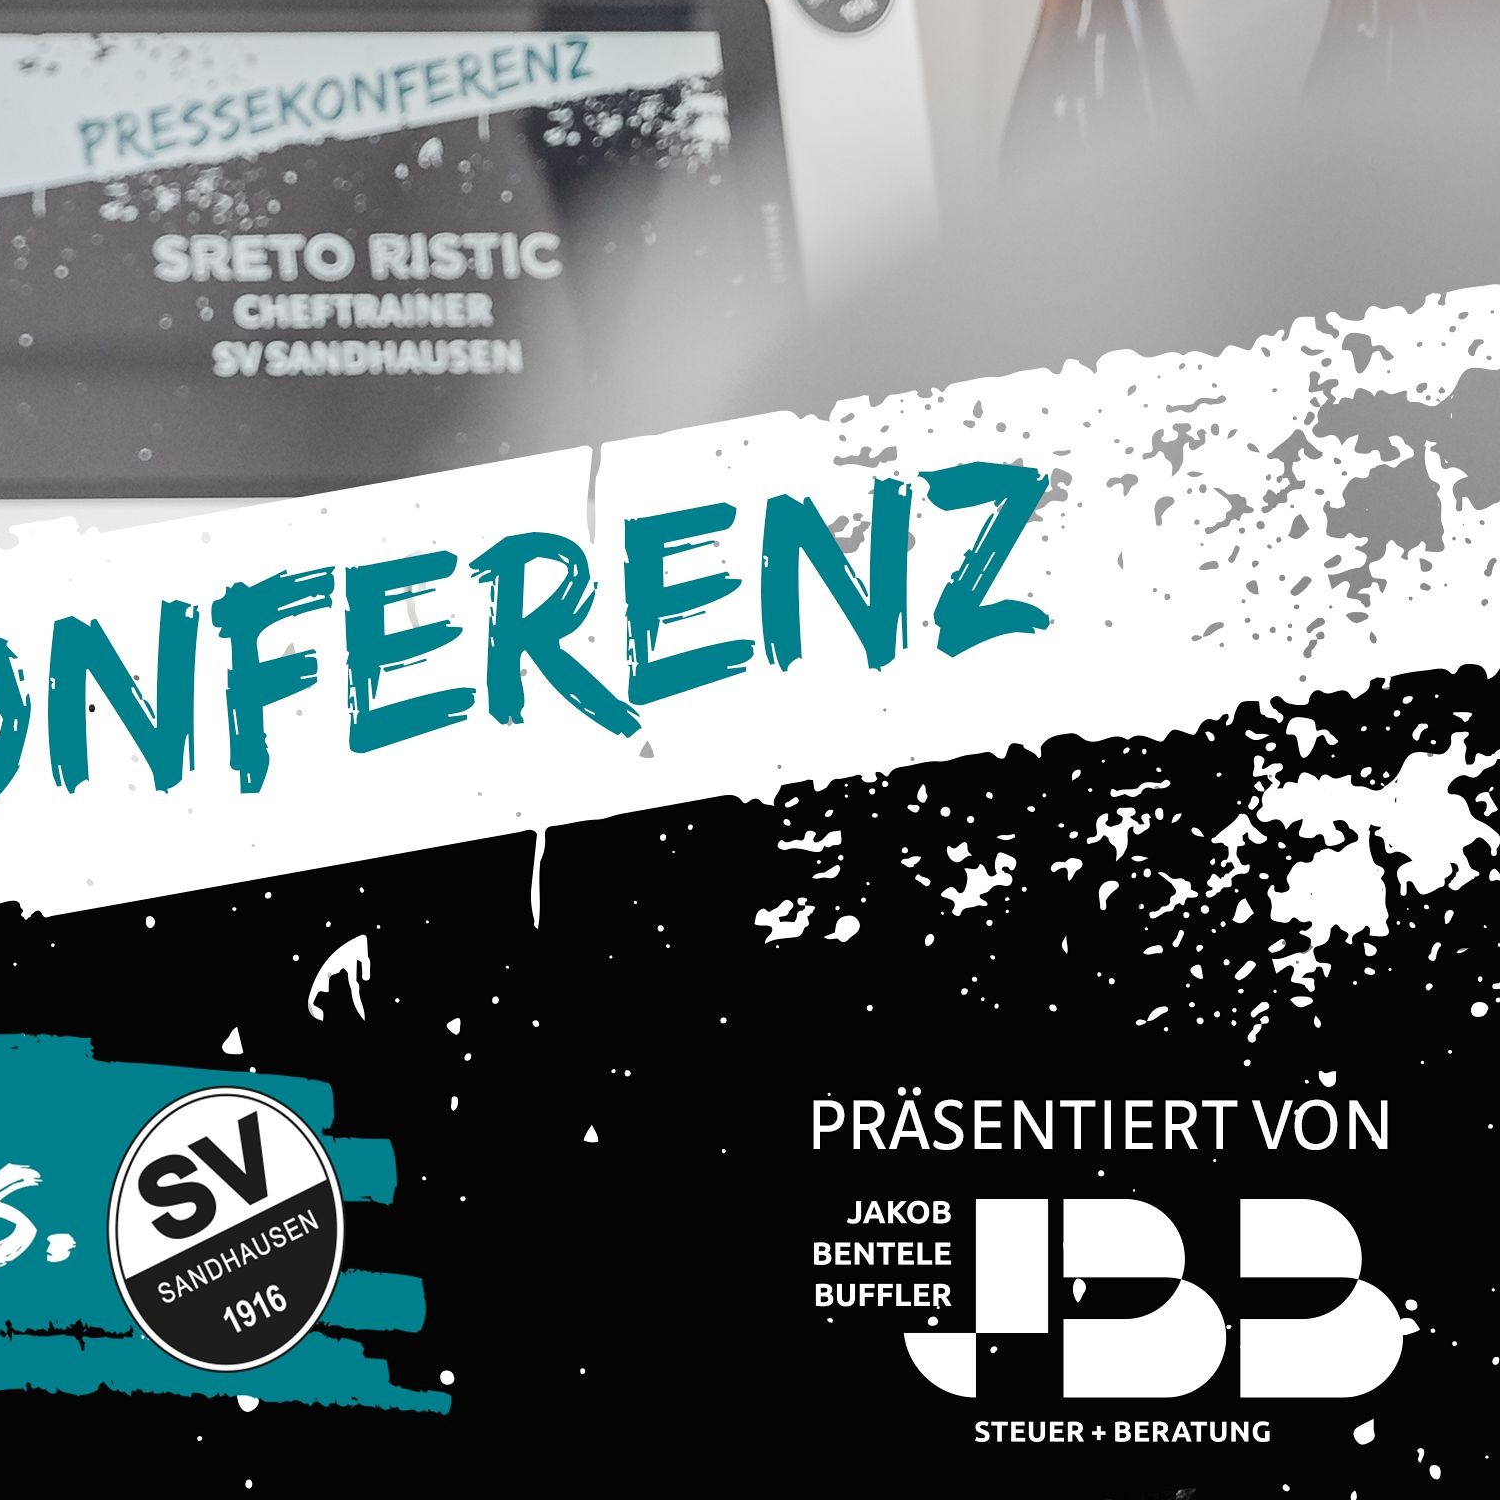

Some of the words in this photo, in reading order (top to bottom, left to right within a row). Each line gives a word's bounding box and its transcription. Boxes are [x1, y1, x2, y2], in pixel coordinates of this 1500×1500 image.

[78, 38, 594, 168] PRESSEKONFERENZ
[152, 233, 356, 283] SRETO
[368, 232, 563, 281] RISTIC
[233, 292, 494, 330] CHEFTRAINER
[212, 341, 263, 378] SV
[264, 339, 524, 377] SANDHAUSEN
